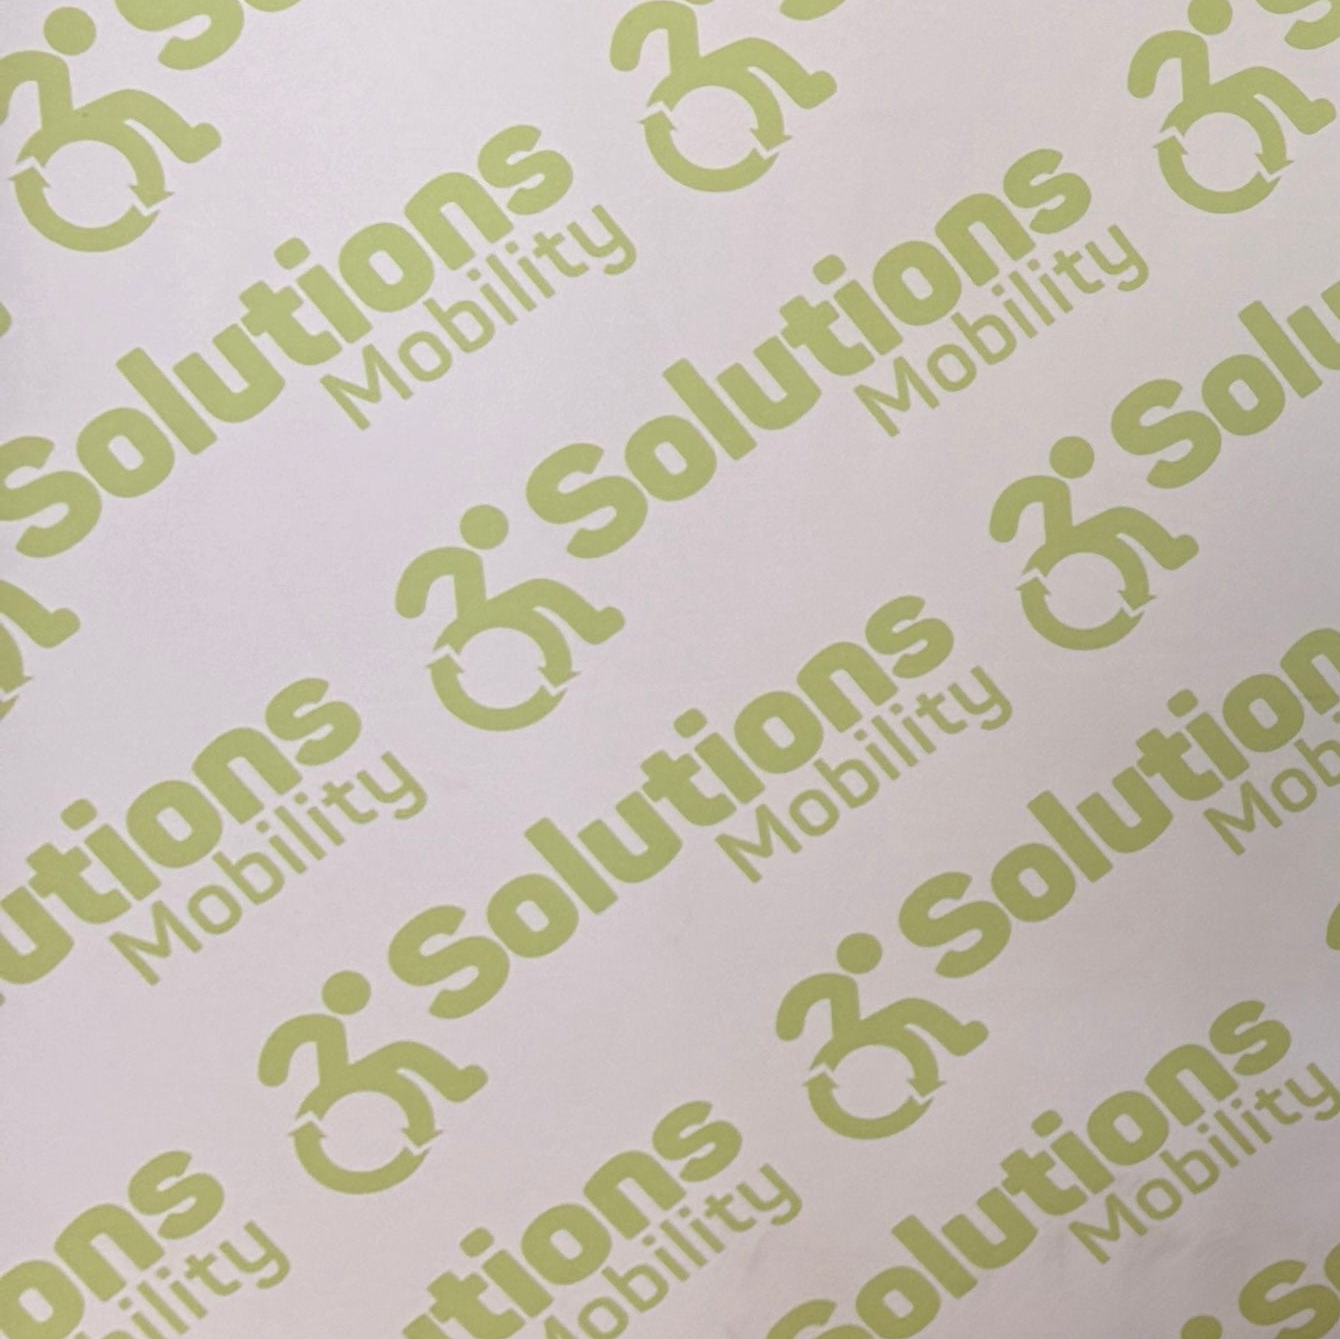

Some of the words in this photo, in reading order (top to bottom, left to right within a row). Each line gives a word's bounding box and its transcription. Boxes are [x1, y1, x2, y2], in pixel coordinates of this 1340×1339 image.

[0, 124, 574, 558] Solutions
[320, 204, 638, 430] Mobility
[526, 148, 1091, 559] Solutions
[854, 224, 1149, 438] Mobility
[109, 751, 427, 986] Mobility
[389, 595, 954, 1020] Solutions
[715, 664, 1012, 884] Mobility
